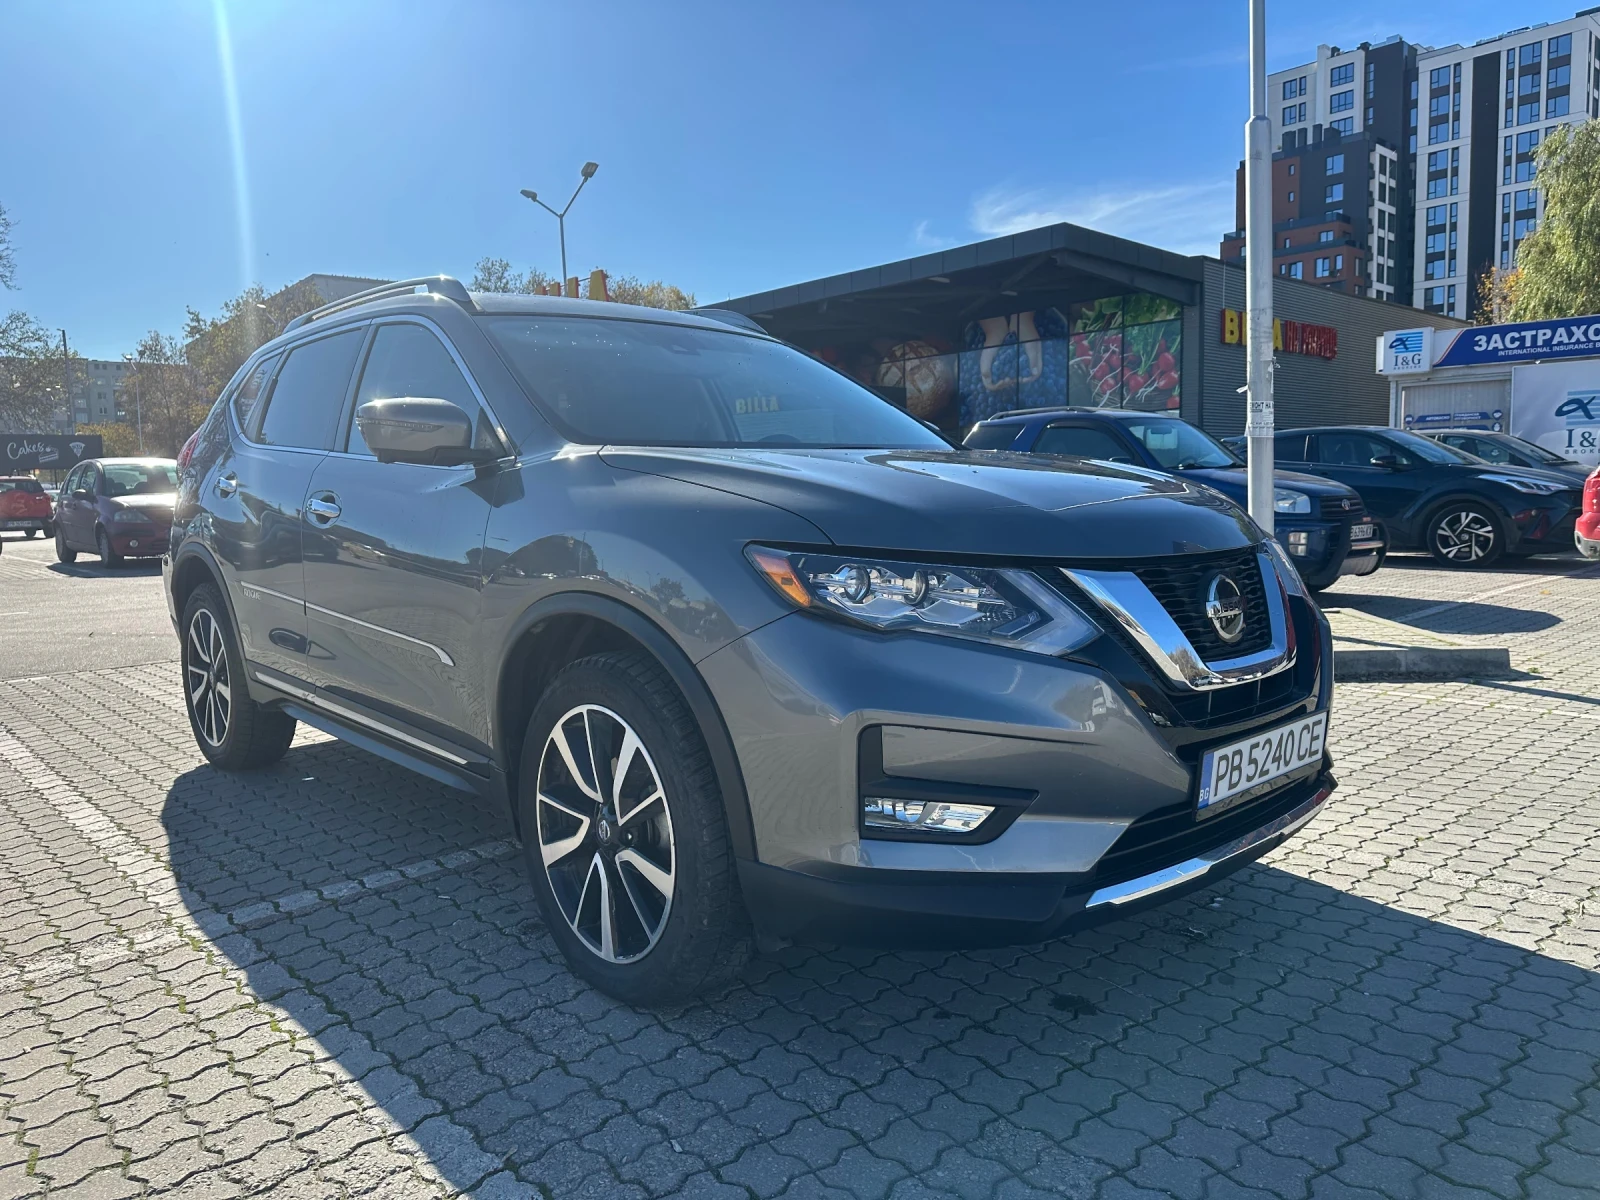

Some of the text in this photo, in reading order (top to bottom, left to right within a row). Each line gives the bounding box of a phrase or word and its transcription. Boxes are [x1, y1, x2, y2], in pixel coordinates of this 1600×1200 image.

[1221, 308, 1283, 351] BIA
[1473, 323, 1600, 352] ЗАСТРАХО
[1498, 346, 1551, 356] INTERNATIONAL
[1552, 342, 1594, 352] INSURANCE
[736, 396, 780, 414] BILLA
[7, 440, 44, 460] Cakes
[1213, 719, 1322, 797] PB 5240 CE
[1199, 787, 1210, 802] BG
